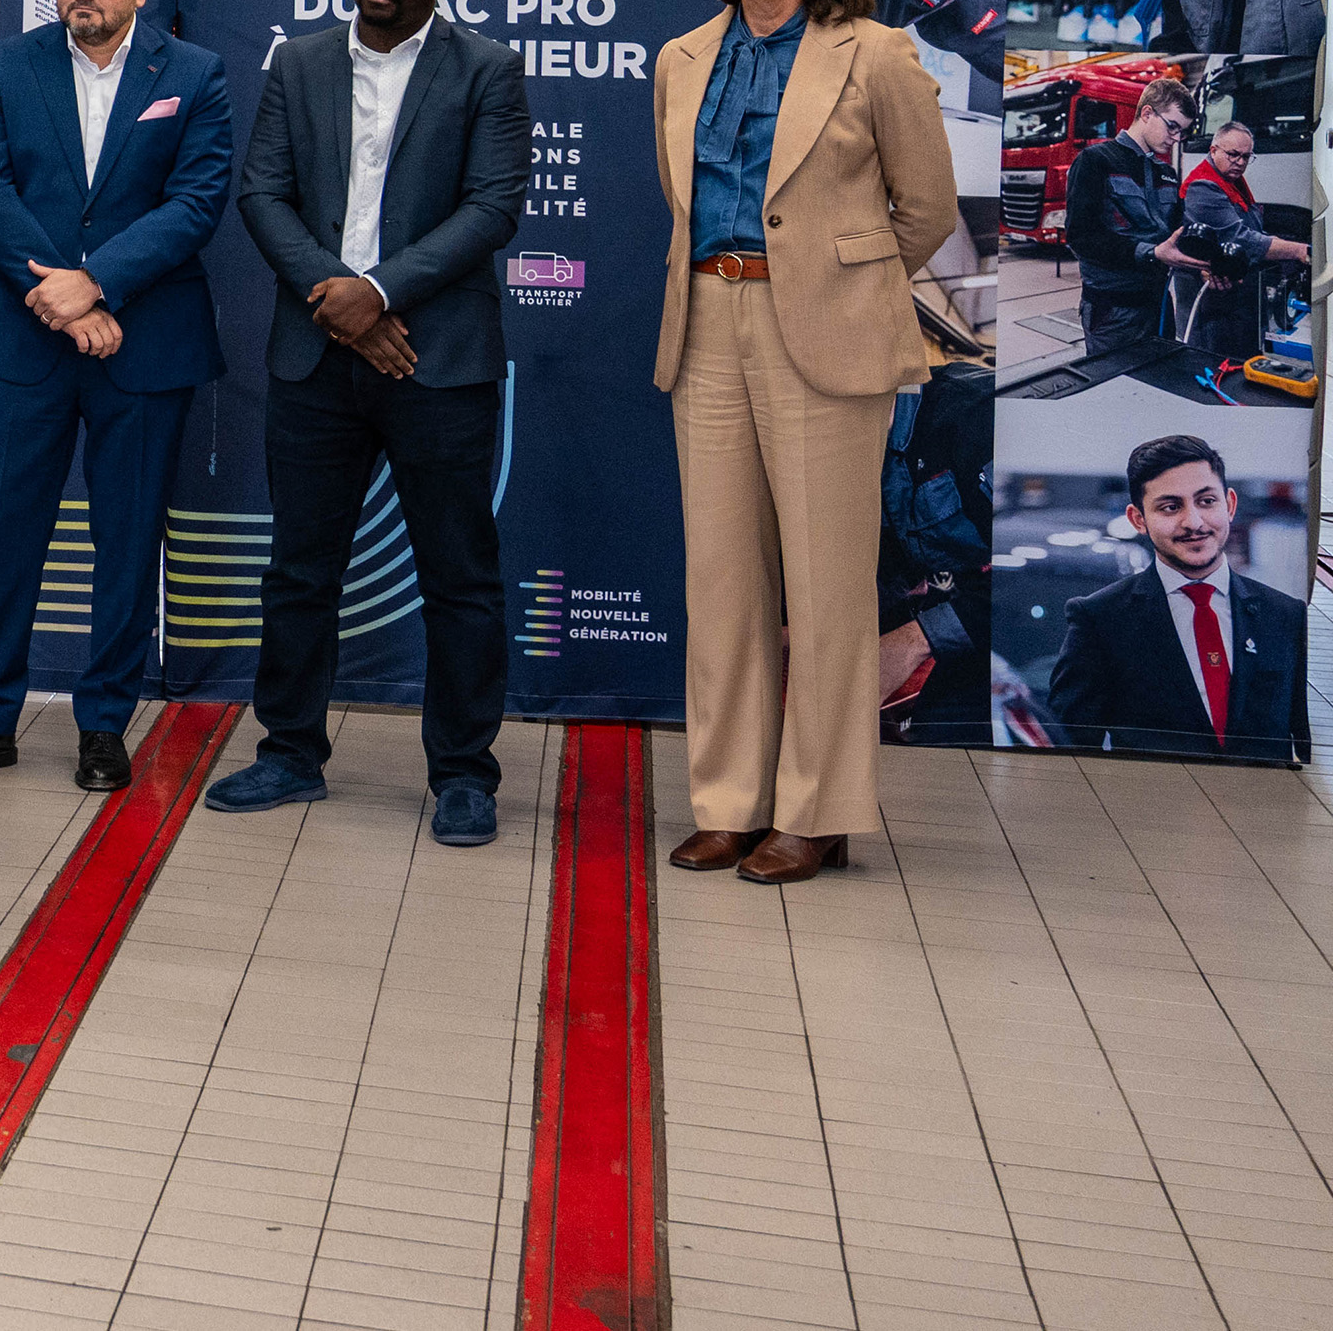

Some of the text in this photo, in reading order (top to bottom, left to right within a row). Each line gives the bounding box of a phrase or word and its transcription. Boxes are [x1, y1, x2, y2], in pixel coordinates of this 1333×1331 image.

[509, 289, 583, 299] TRANSPORT
[518, 297, 573, 307] ROUTIER
[571, 589, 642, 603] MOBILITÉ
[570, 609, 650, 623] NOUVELLE
[569, 627, 668, 643] GÉNÉRATION
